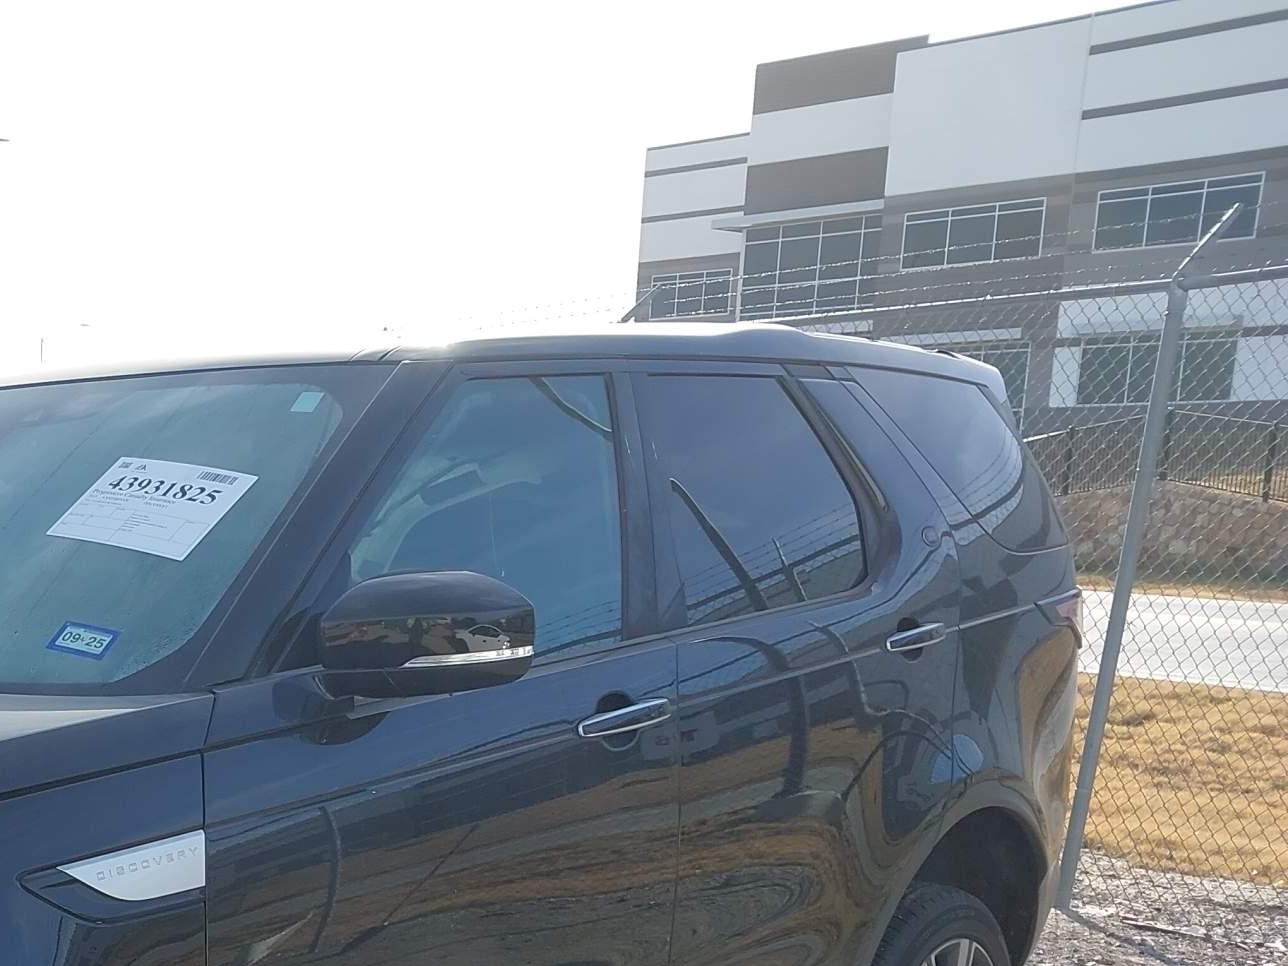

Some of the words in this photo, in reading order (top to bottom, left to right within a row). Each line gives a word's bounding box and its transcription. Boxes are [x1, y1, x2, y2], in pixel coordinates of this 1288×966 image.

[108, 475, 224, 505] 43931825
[62, 631, 82, 643] 09
[84, 636, 107, 649] 25
[96, 846, 199, 881] DISCOVERY
